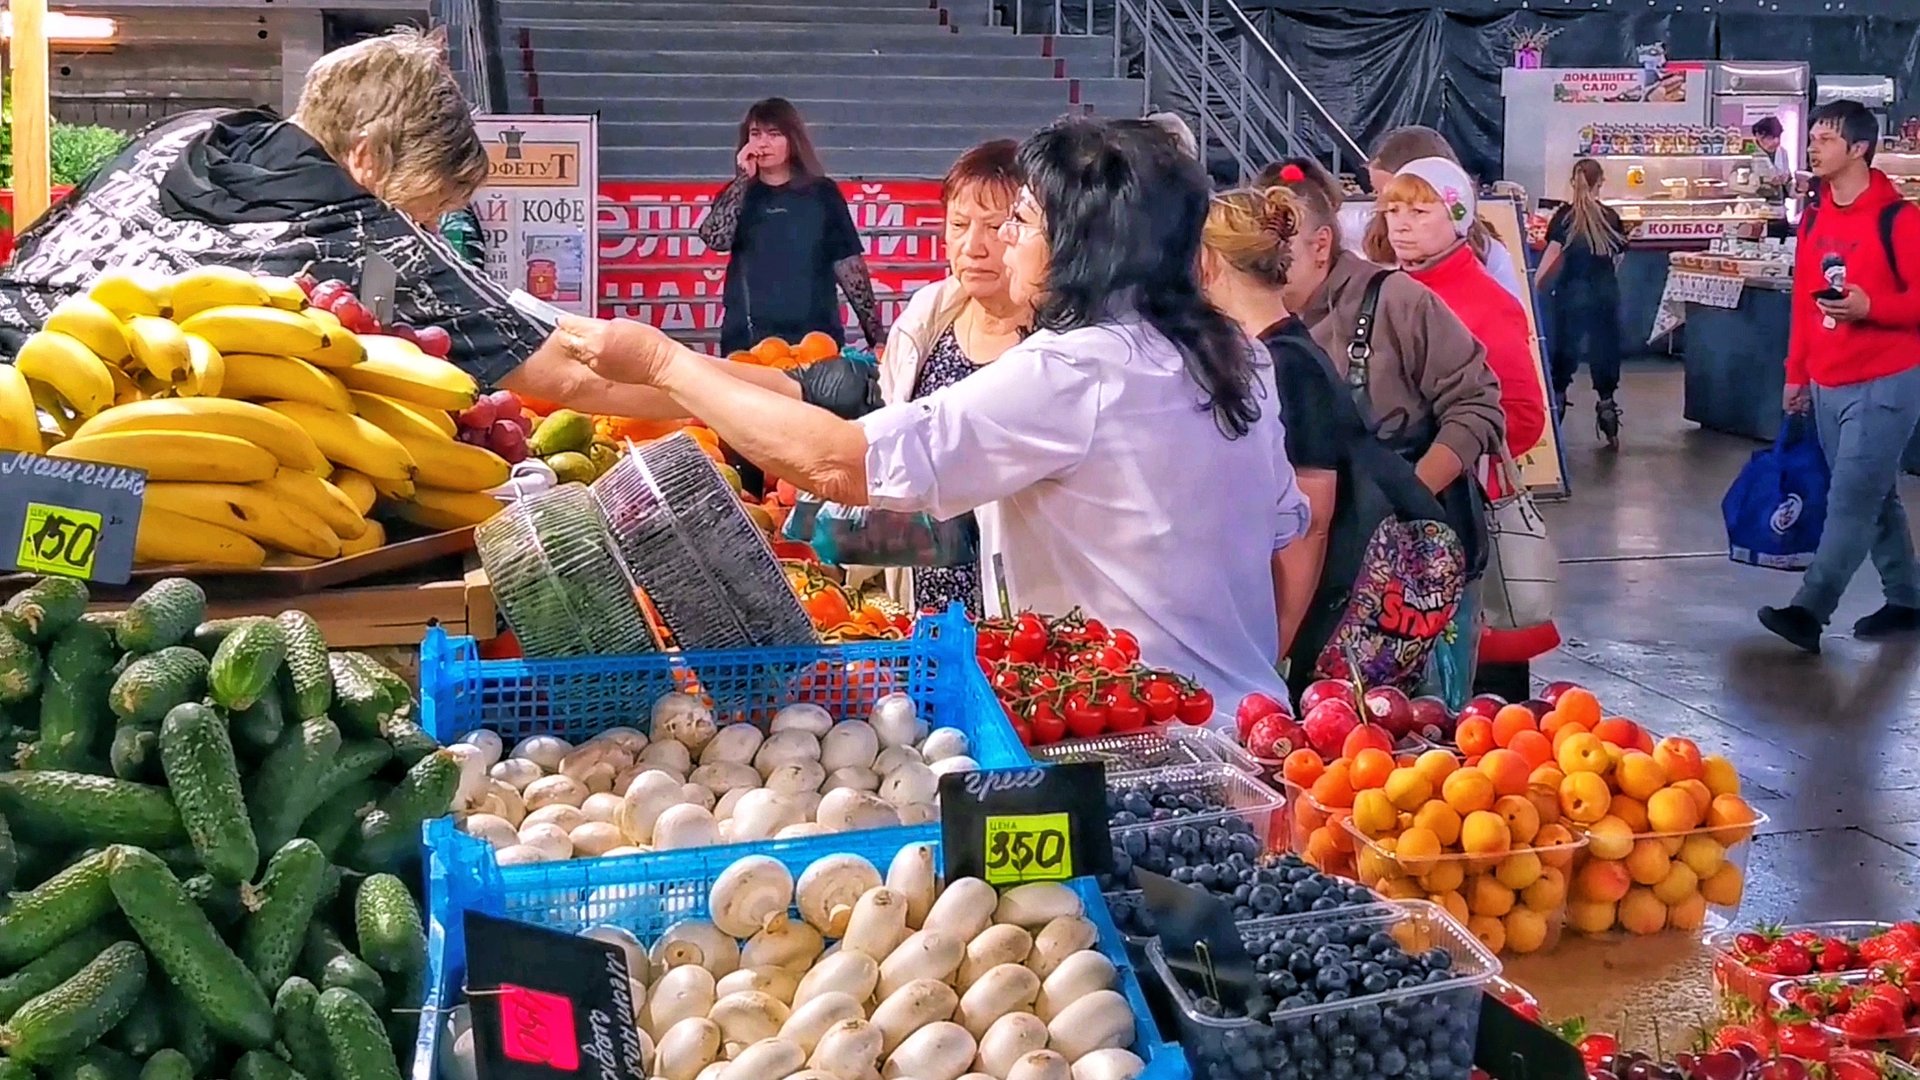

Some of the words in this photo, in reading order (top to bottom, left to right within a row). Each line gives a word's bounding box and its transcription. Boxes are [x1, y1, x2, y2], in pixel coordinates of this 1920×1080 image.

[1562, 72, 1638, 82] ДОМАШНЕЕ
[1582, 83, 1618, 92] САЛО
[487, 153, 575, 180] ОФЕТУТ
[522, 198, 585, 224] КОФЕ
[31, 514, 99, 568] 150
[988, 821, 1018, 831] ЦЕНА
[986, 829, 1067, 870] 350
